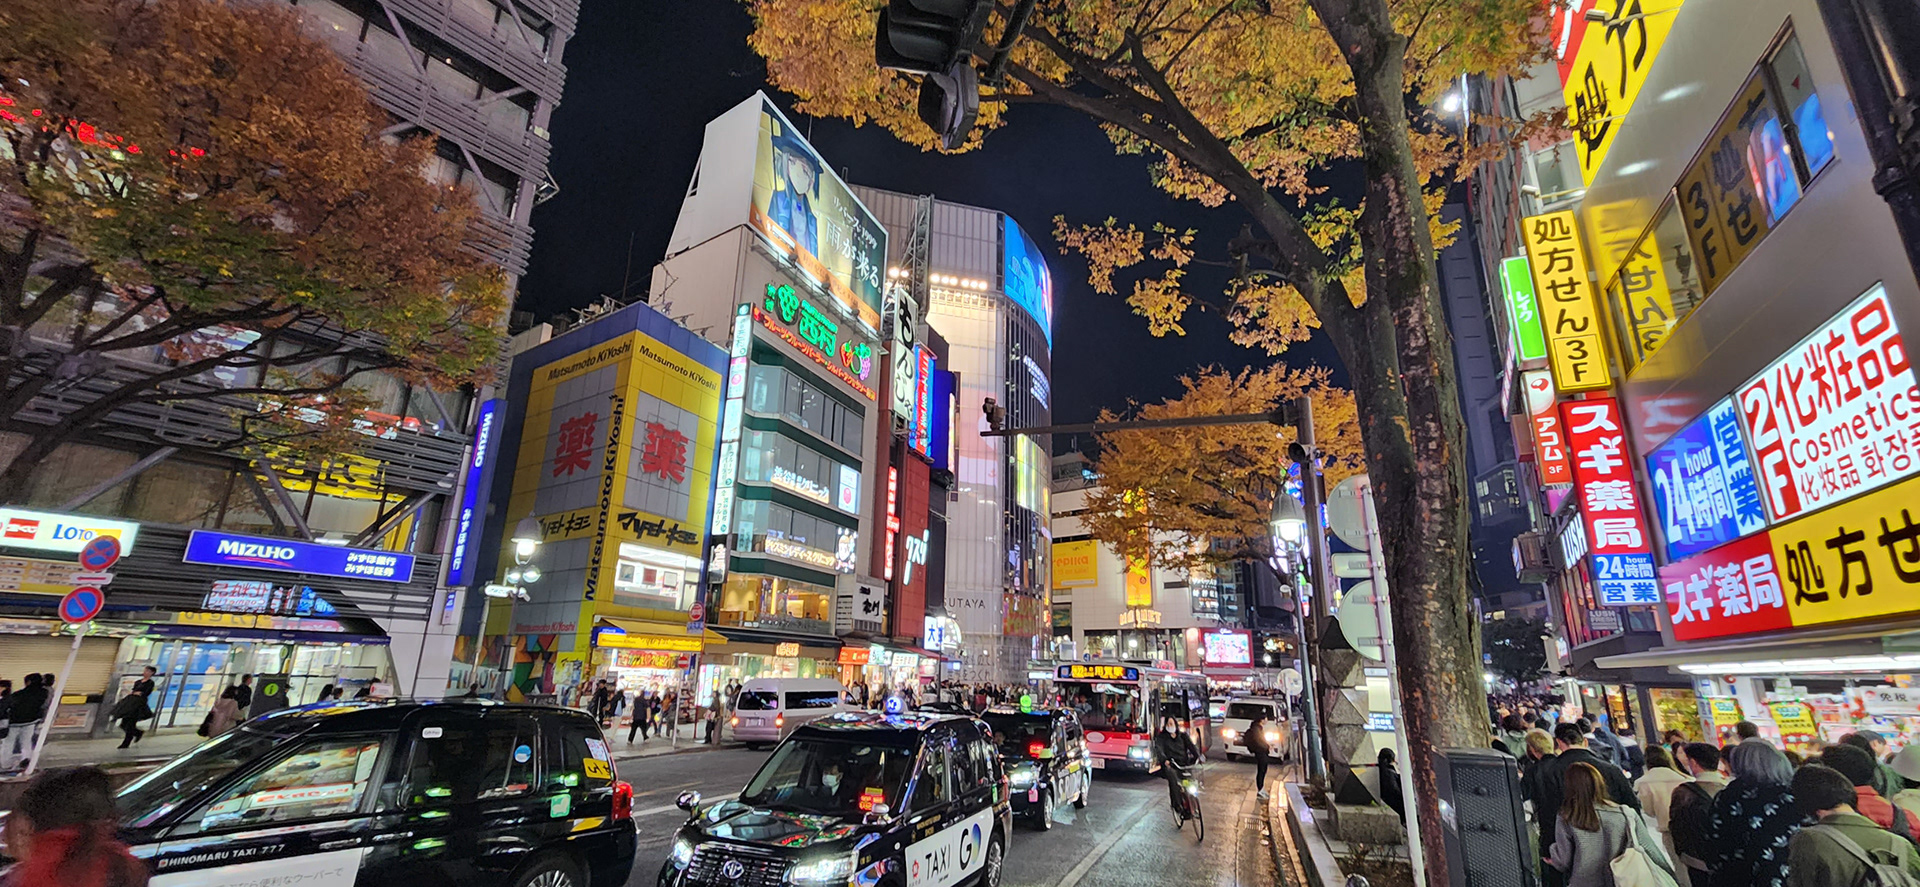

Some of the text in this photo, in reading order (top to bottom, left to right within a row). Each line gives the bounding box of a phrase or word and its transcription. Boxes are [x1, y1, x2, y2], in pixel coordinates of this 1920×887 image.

[1534, 218, 1588, 335] 処方せん
[798, 308, 837, 357] 西村
[1515, 290, 1533, 323] レイク
[548, 339, 632, 381] Matsumoto KiYoshi
[639, 345, 717, 391] Matsumoto KiYoshi
[1775, 297, 1911, 434] 化粧品
[475, 412, 493, 468] MIZUHO
[553, 411, 598, 478] 薬
[641, 421, 689, 484] 薬
[1537, 417, 1563, 475] アコム 3F
[1744, 386, 1788, 516] 2F
[1790, 384, 1920, 468] Cosmetics
[1571, 404, 1643, 549] スギ薬局
[1685, 445, 1712, 477] hour
[1715, 406, 1763, 527] 営業
[585, 472, 613, 601] Matsumoto
[605, 397, 624, 471] KiYoshi
[217, 539, 295, 560] MIZUHO
[347, 552, 397, 566] みずほ銀行
[1563, 514, 1587, 565] LUSH
[1626, 556, 1647, 564] hour
[1602, 583, 1658, 602] 営業
[1666, 553, 1784, 624] スギ薬局
[169, 844, 285, 867] HINOMARU TAXI 777
[925, 844, 950, 881] TAXI
